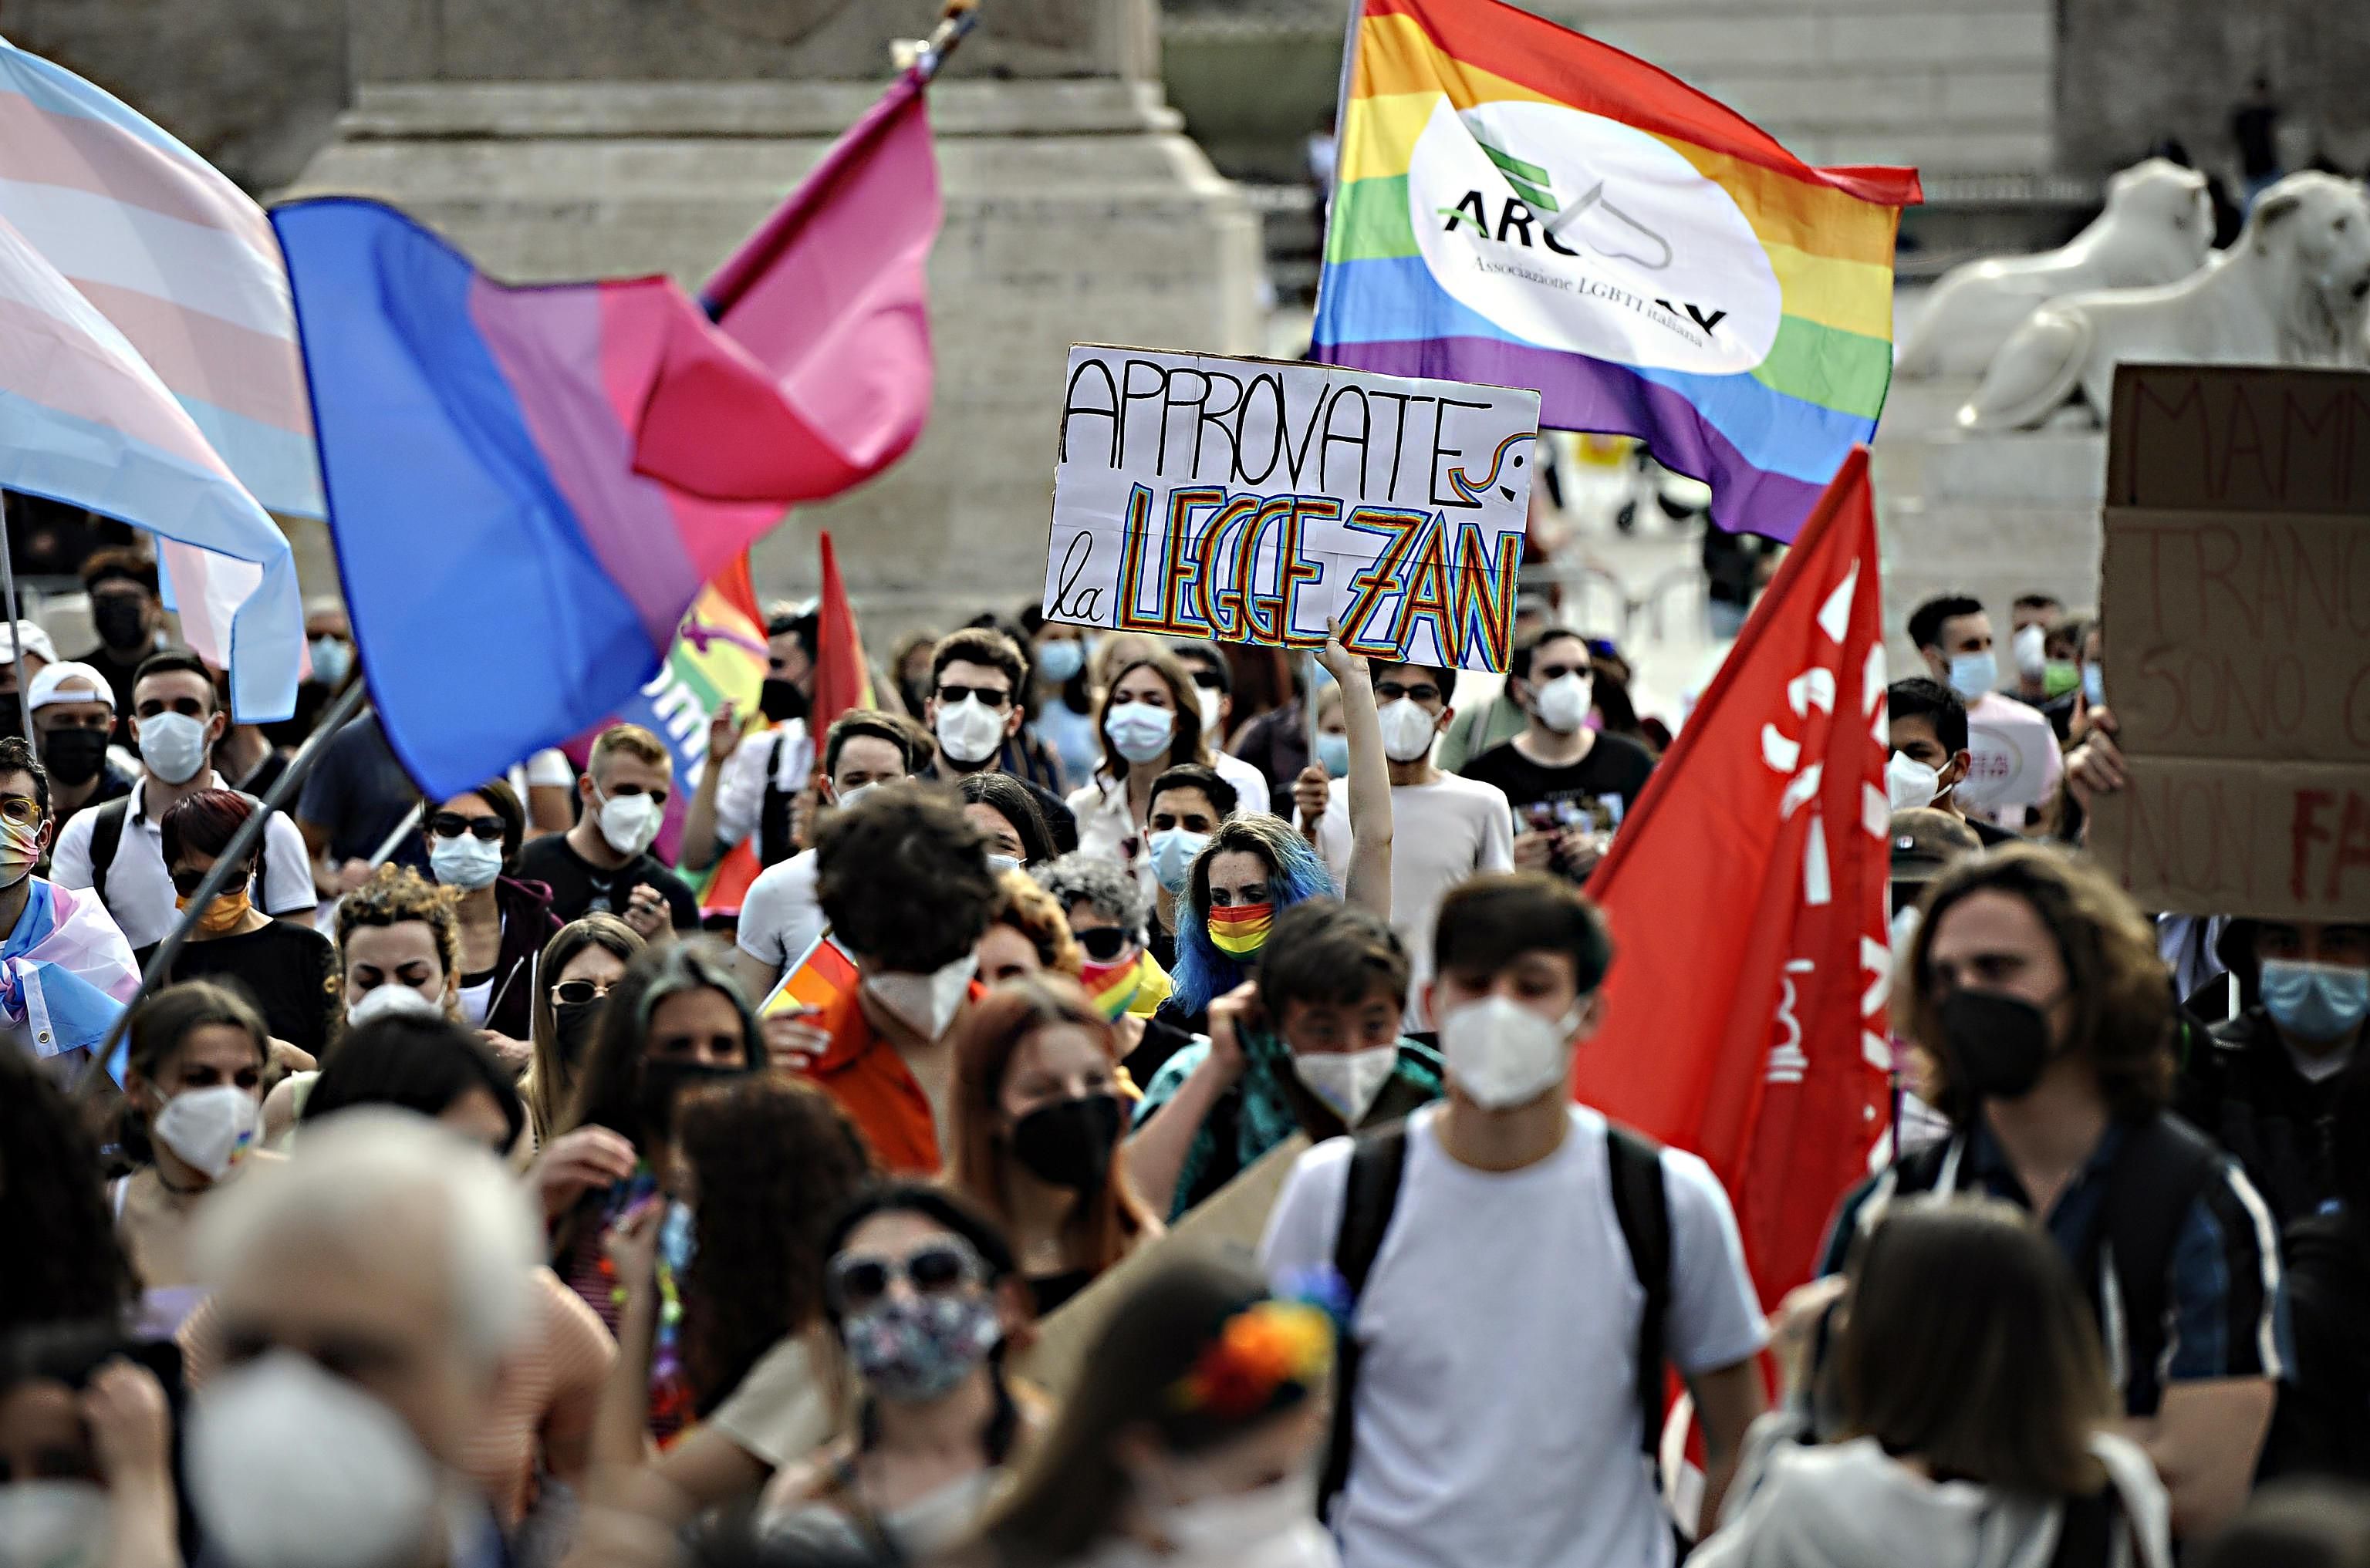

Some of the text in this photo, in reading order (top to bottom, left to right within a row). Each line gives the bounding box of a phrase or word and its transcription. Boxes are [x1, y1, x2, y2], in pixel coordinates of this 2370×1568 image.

[1474, 255, 1703, 347] Associazione LGBTI italiana
[1062, 359, 1492, 508] APPROVATE
[1048, 481, 1525, 674] la LEGGE ZAN
[2137, 643, 2308, 740] SONO
